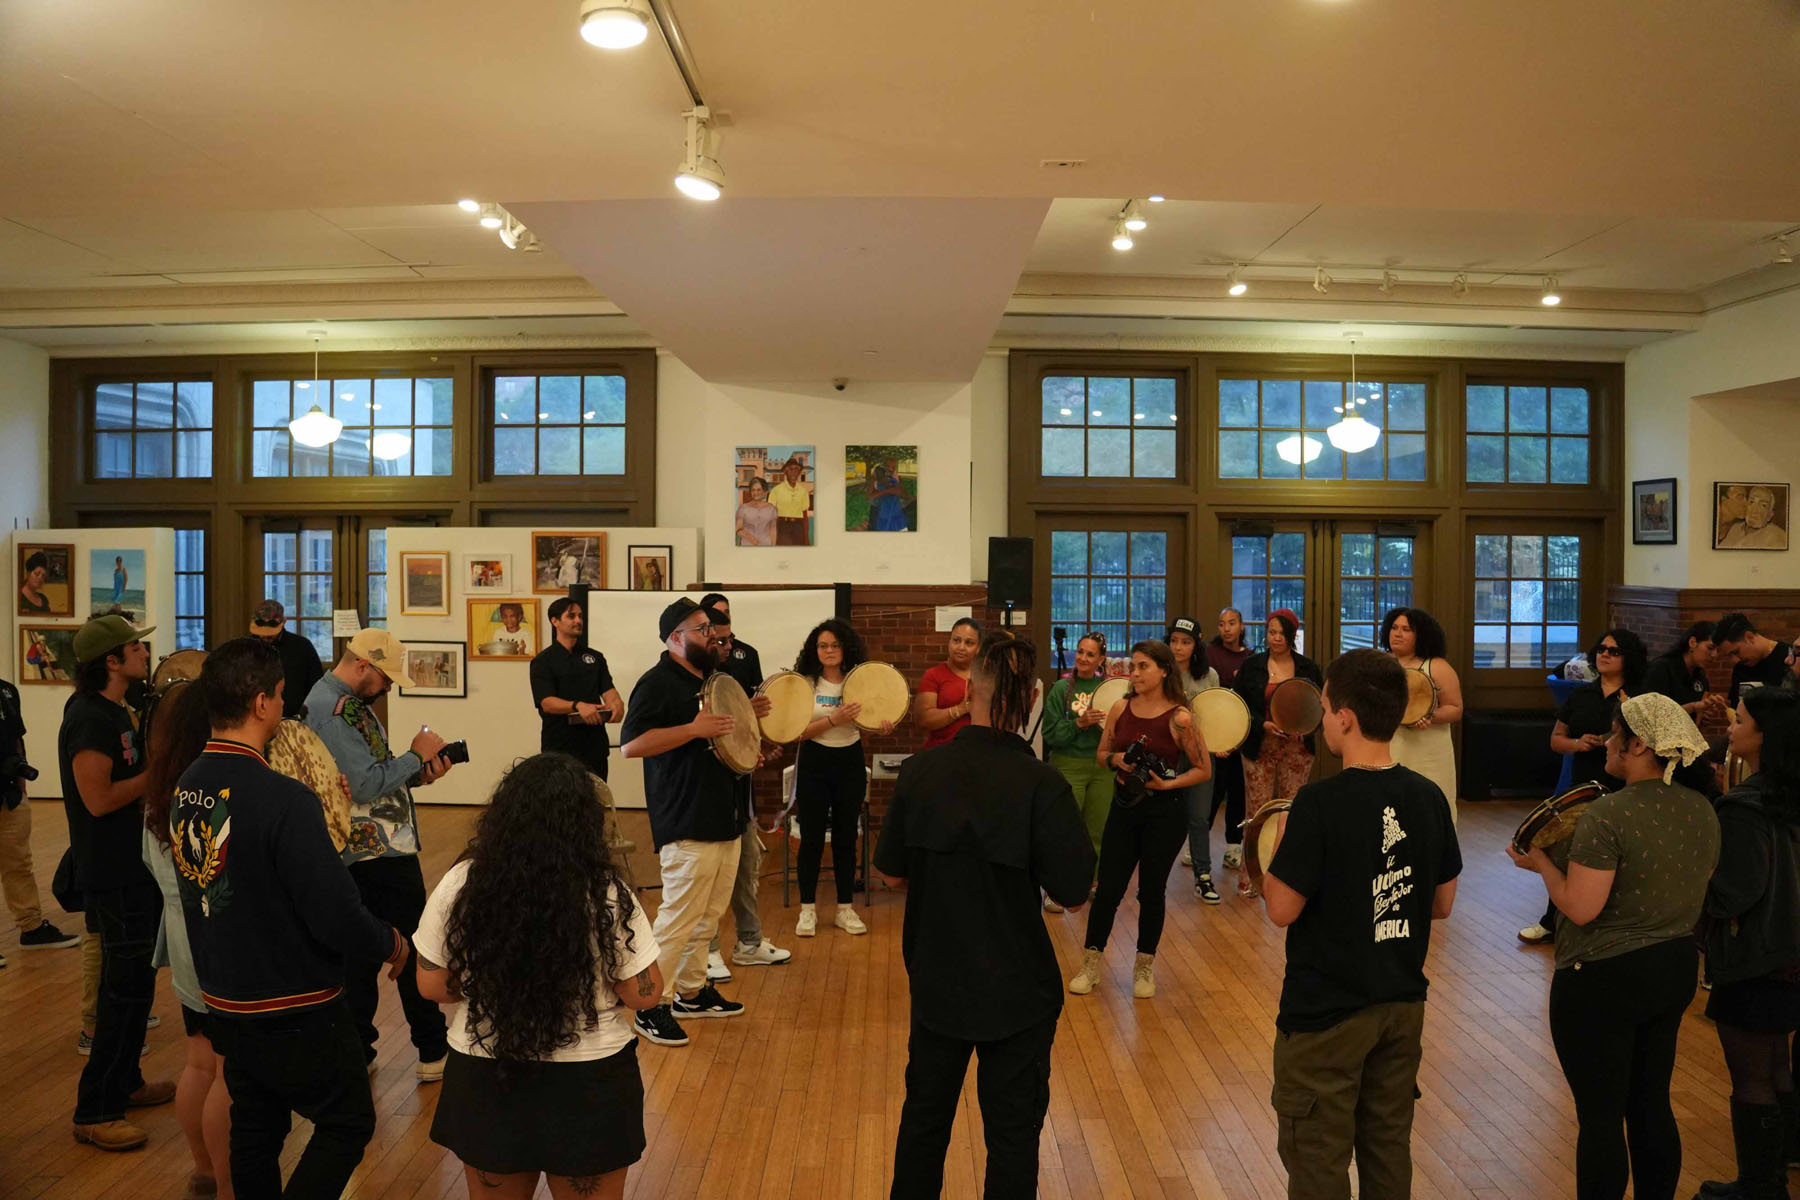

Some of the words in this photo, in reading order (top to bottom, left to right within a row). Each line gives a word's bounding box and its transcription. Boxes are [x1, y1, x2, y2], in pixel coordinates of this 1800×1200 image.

[178, 789, 215, 809] Polo
[1392, 903, 1400, 911] de
[1375, 919, 1410, 943] AMERICA
